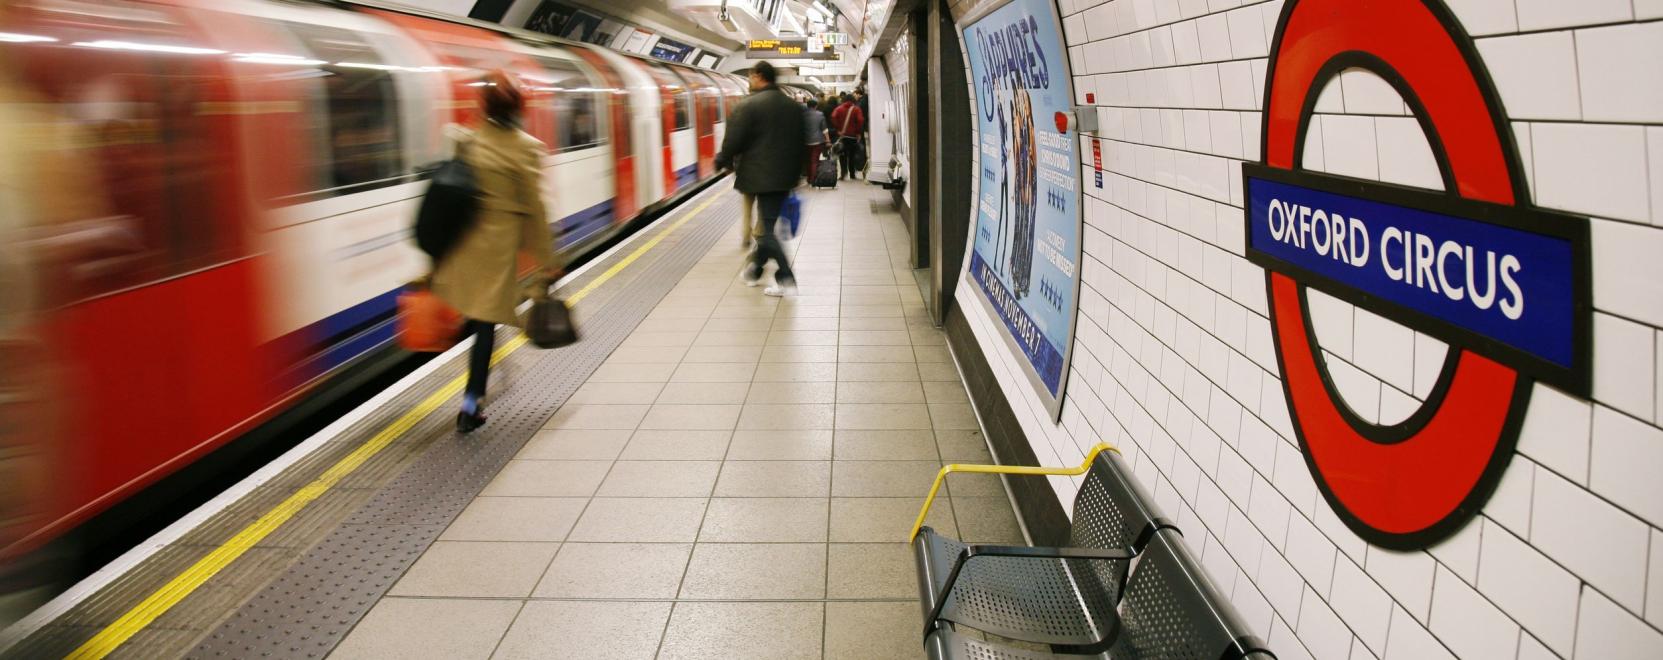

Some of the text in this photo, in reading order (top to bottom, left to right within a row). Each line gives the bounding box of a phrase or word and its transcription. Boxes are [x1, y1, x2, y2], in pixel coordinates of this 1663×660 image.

[981, 263, 988, 282] IN
[985, 270, 1005, 308] CINEMAS
[1004, 294, 1036, 351] NOVEMBER
[1034, 333, 1041, 355] 7
[1268, 198, 1524, 320] OXFORD CIRCUS
